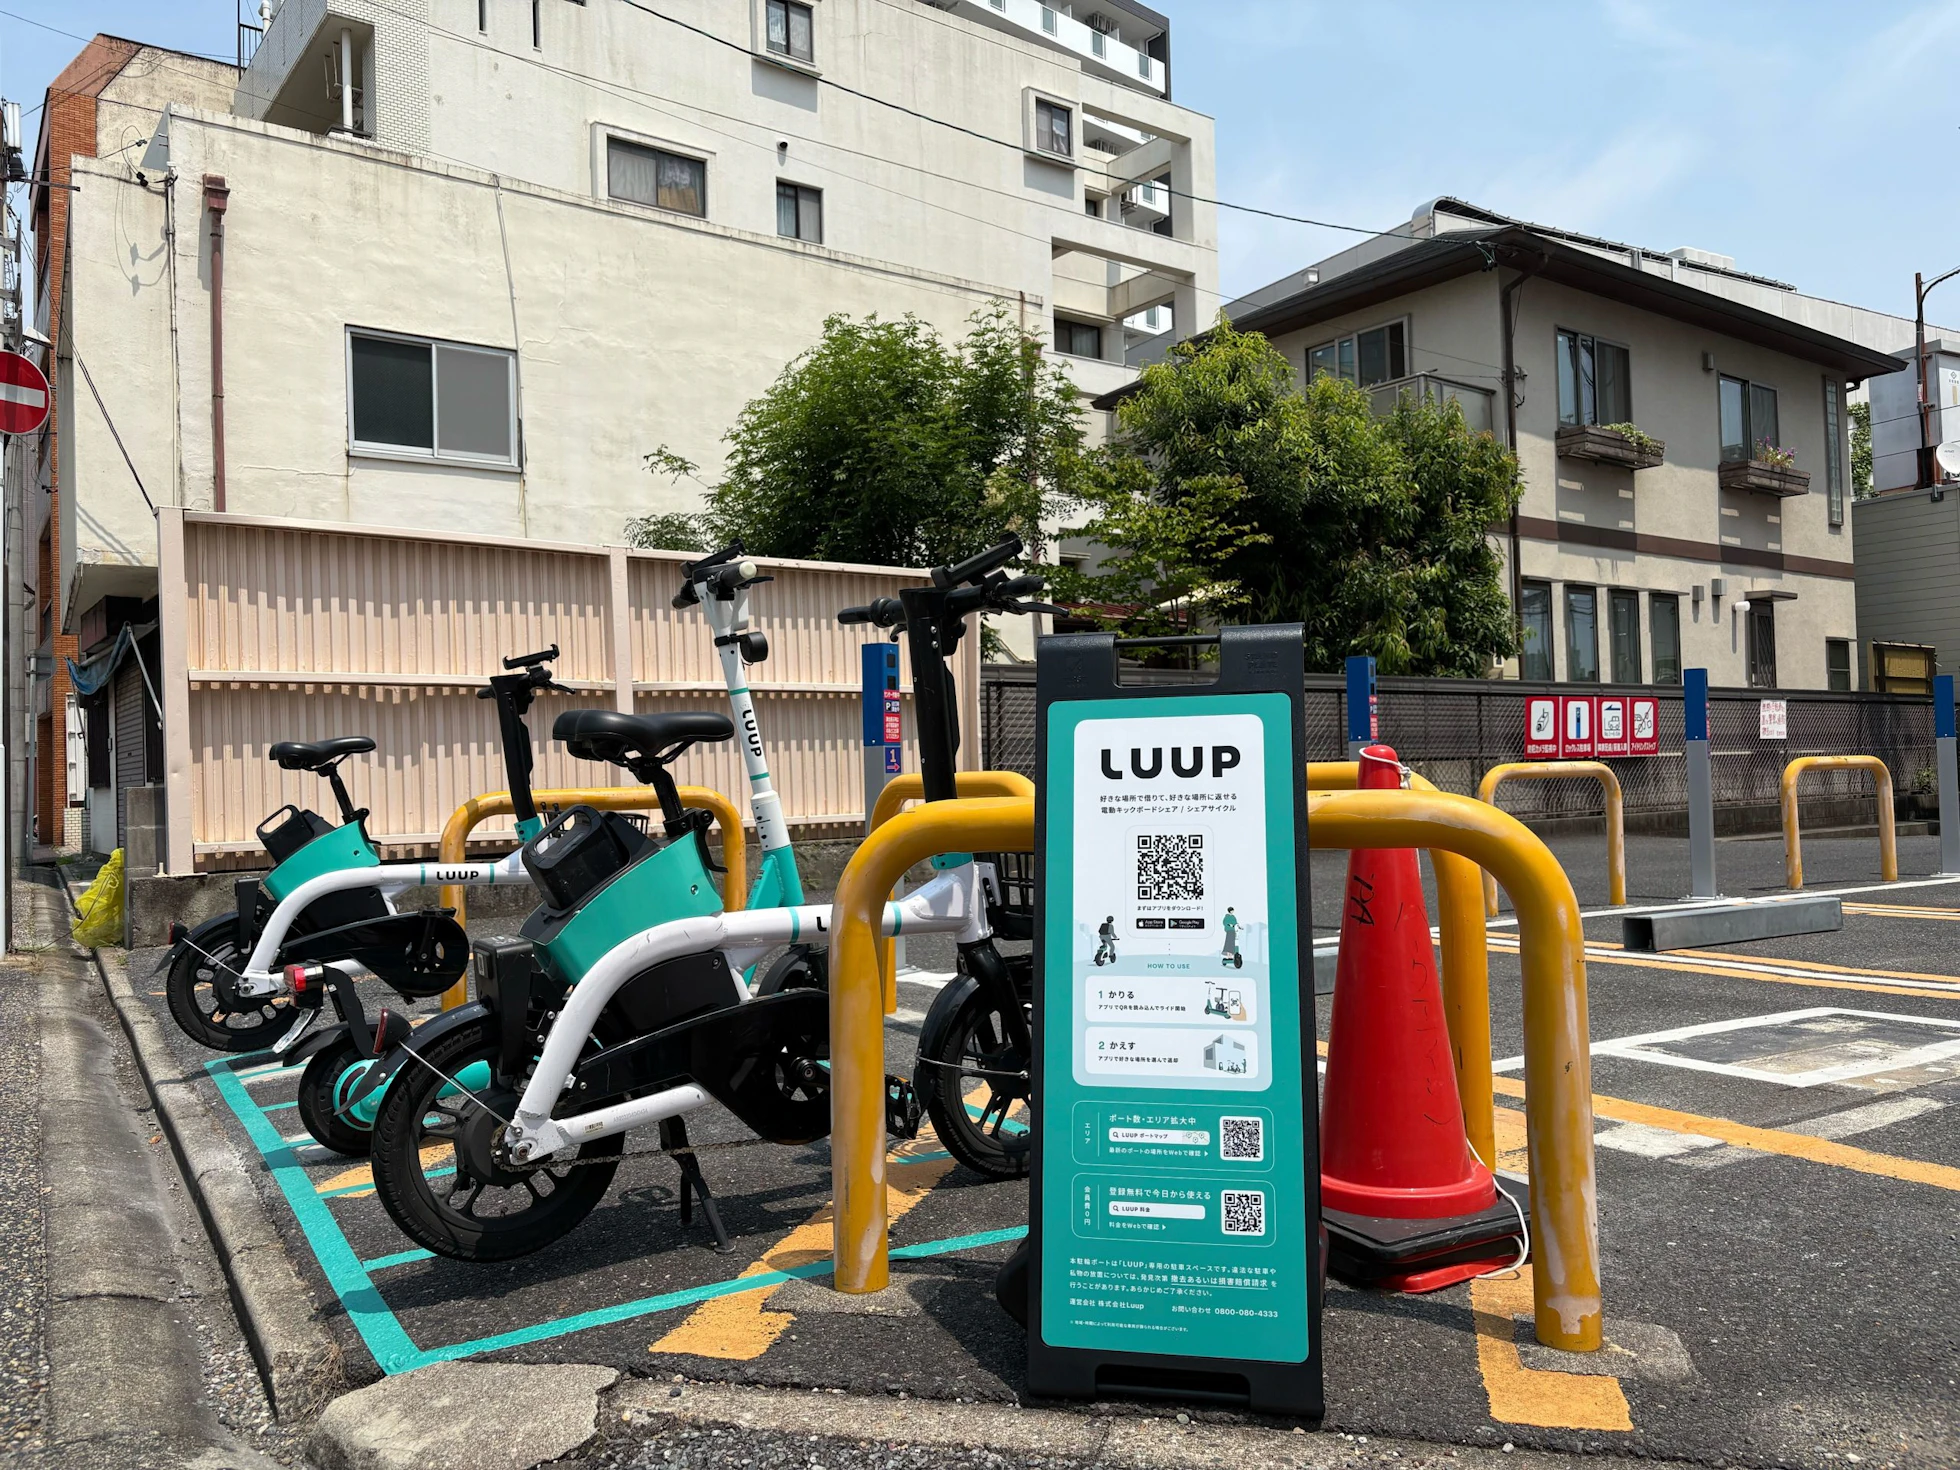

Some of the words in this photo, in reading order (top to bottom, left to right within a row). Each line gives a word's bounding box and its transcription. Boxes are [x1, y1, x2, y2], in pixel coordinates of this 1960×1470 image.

[742, 709, 762, 757] LUUP
[890, 749, 896, 763] 1
[1101, 745, 1241, 780] LUUP
[1099, 793, 1238, 803] 好きな場所で借りて、好きな場所に返せる
[1101, 805, 1179, 814] 電動キックボードシェア
[1186, 804, 1237, 813] シェアサイクル
[436, 870, 479, 881] LUUP
[1098, 990, 1103, 999] 1
[1108, 990, 1135, 999] かりる
[1098, 1004, 1186, 1012] アプリでQRを読み込んでライド開始
[1098, 1041, 1105, 1050] 2
[1109, 1041, 1136, 1050] かえす
[1109, 1114, 1197, 1126] ポート数・エリア拡大中
[1109, 1187, 1211, 1200] 登録無料で今日から使える
[1109, 1221, 1160, 1231] 料金をWebで確認
[1069, 1281, 1212, 1297] 行うことがあります。あらかじめご了承ください。
[1069, 1298, 1095, 1307] 運営会社
[1098, 1300, 1145, 1310] 株式会社Luup
[1171, 1305, 1211, 1314] お問い合わせ
[1214, 1308, 1279, 1318] 0800-080-4333
